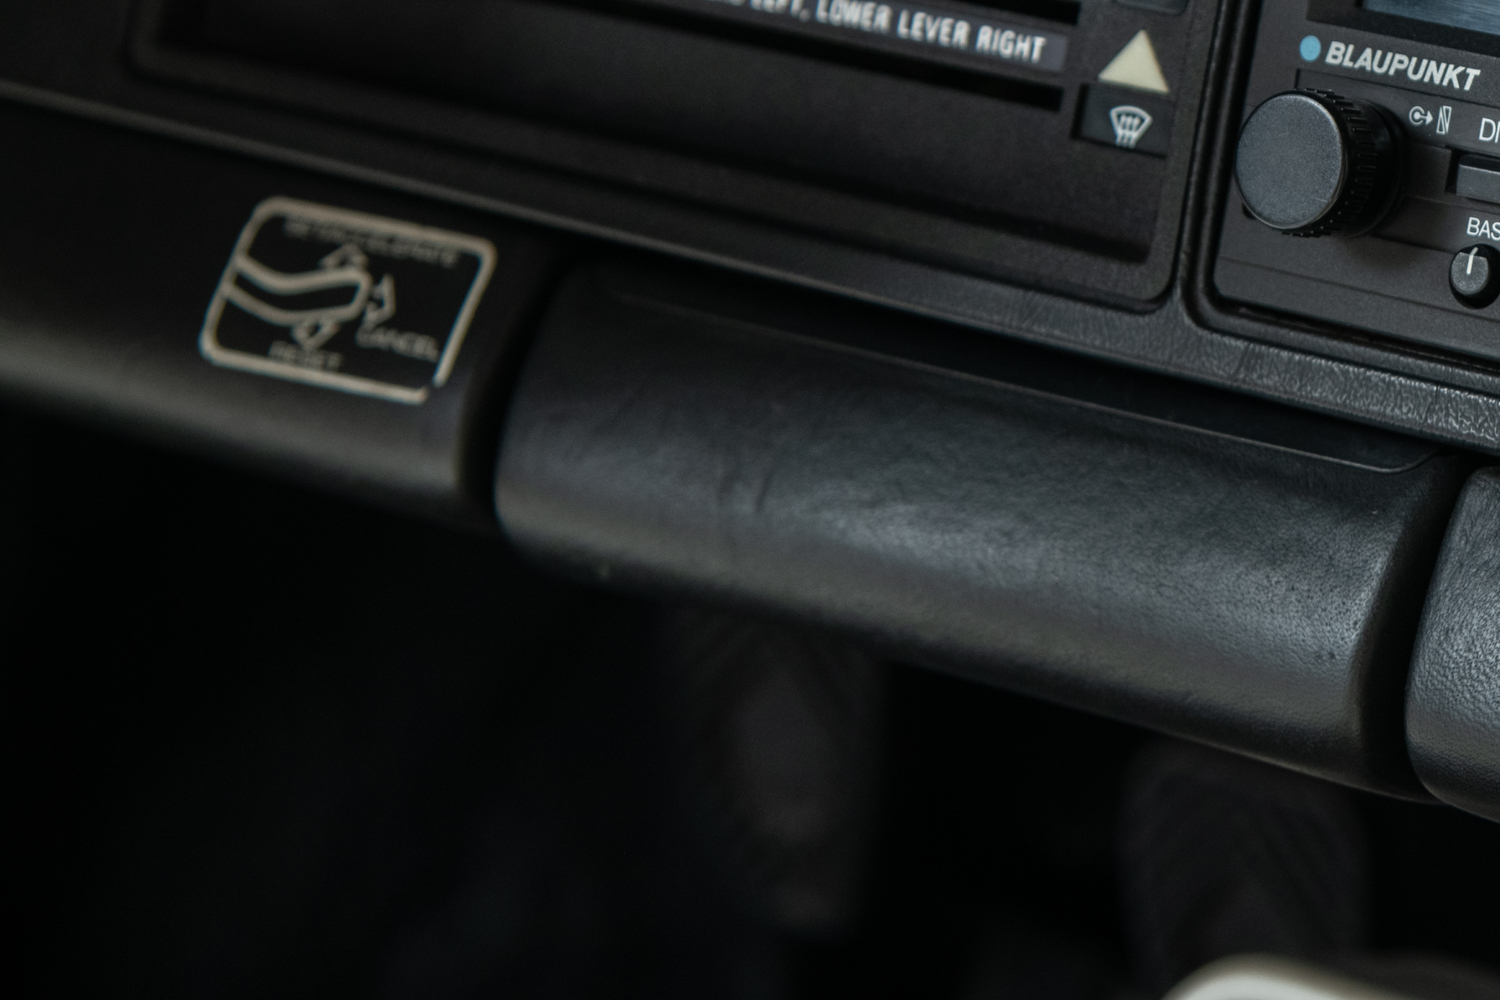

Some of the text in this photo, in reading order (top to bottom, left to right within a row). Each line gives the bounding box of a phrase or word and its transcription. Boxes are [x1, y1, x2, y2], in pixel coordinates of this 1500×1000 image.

[897, 9, 969, 50] LEVER
[976, 25, 1047, 63] RIGHT
[1325, 41, 1480, 91] BLAUPUNKT
